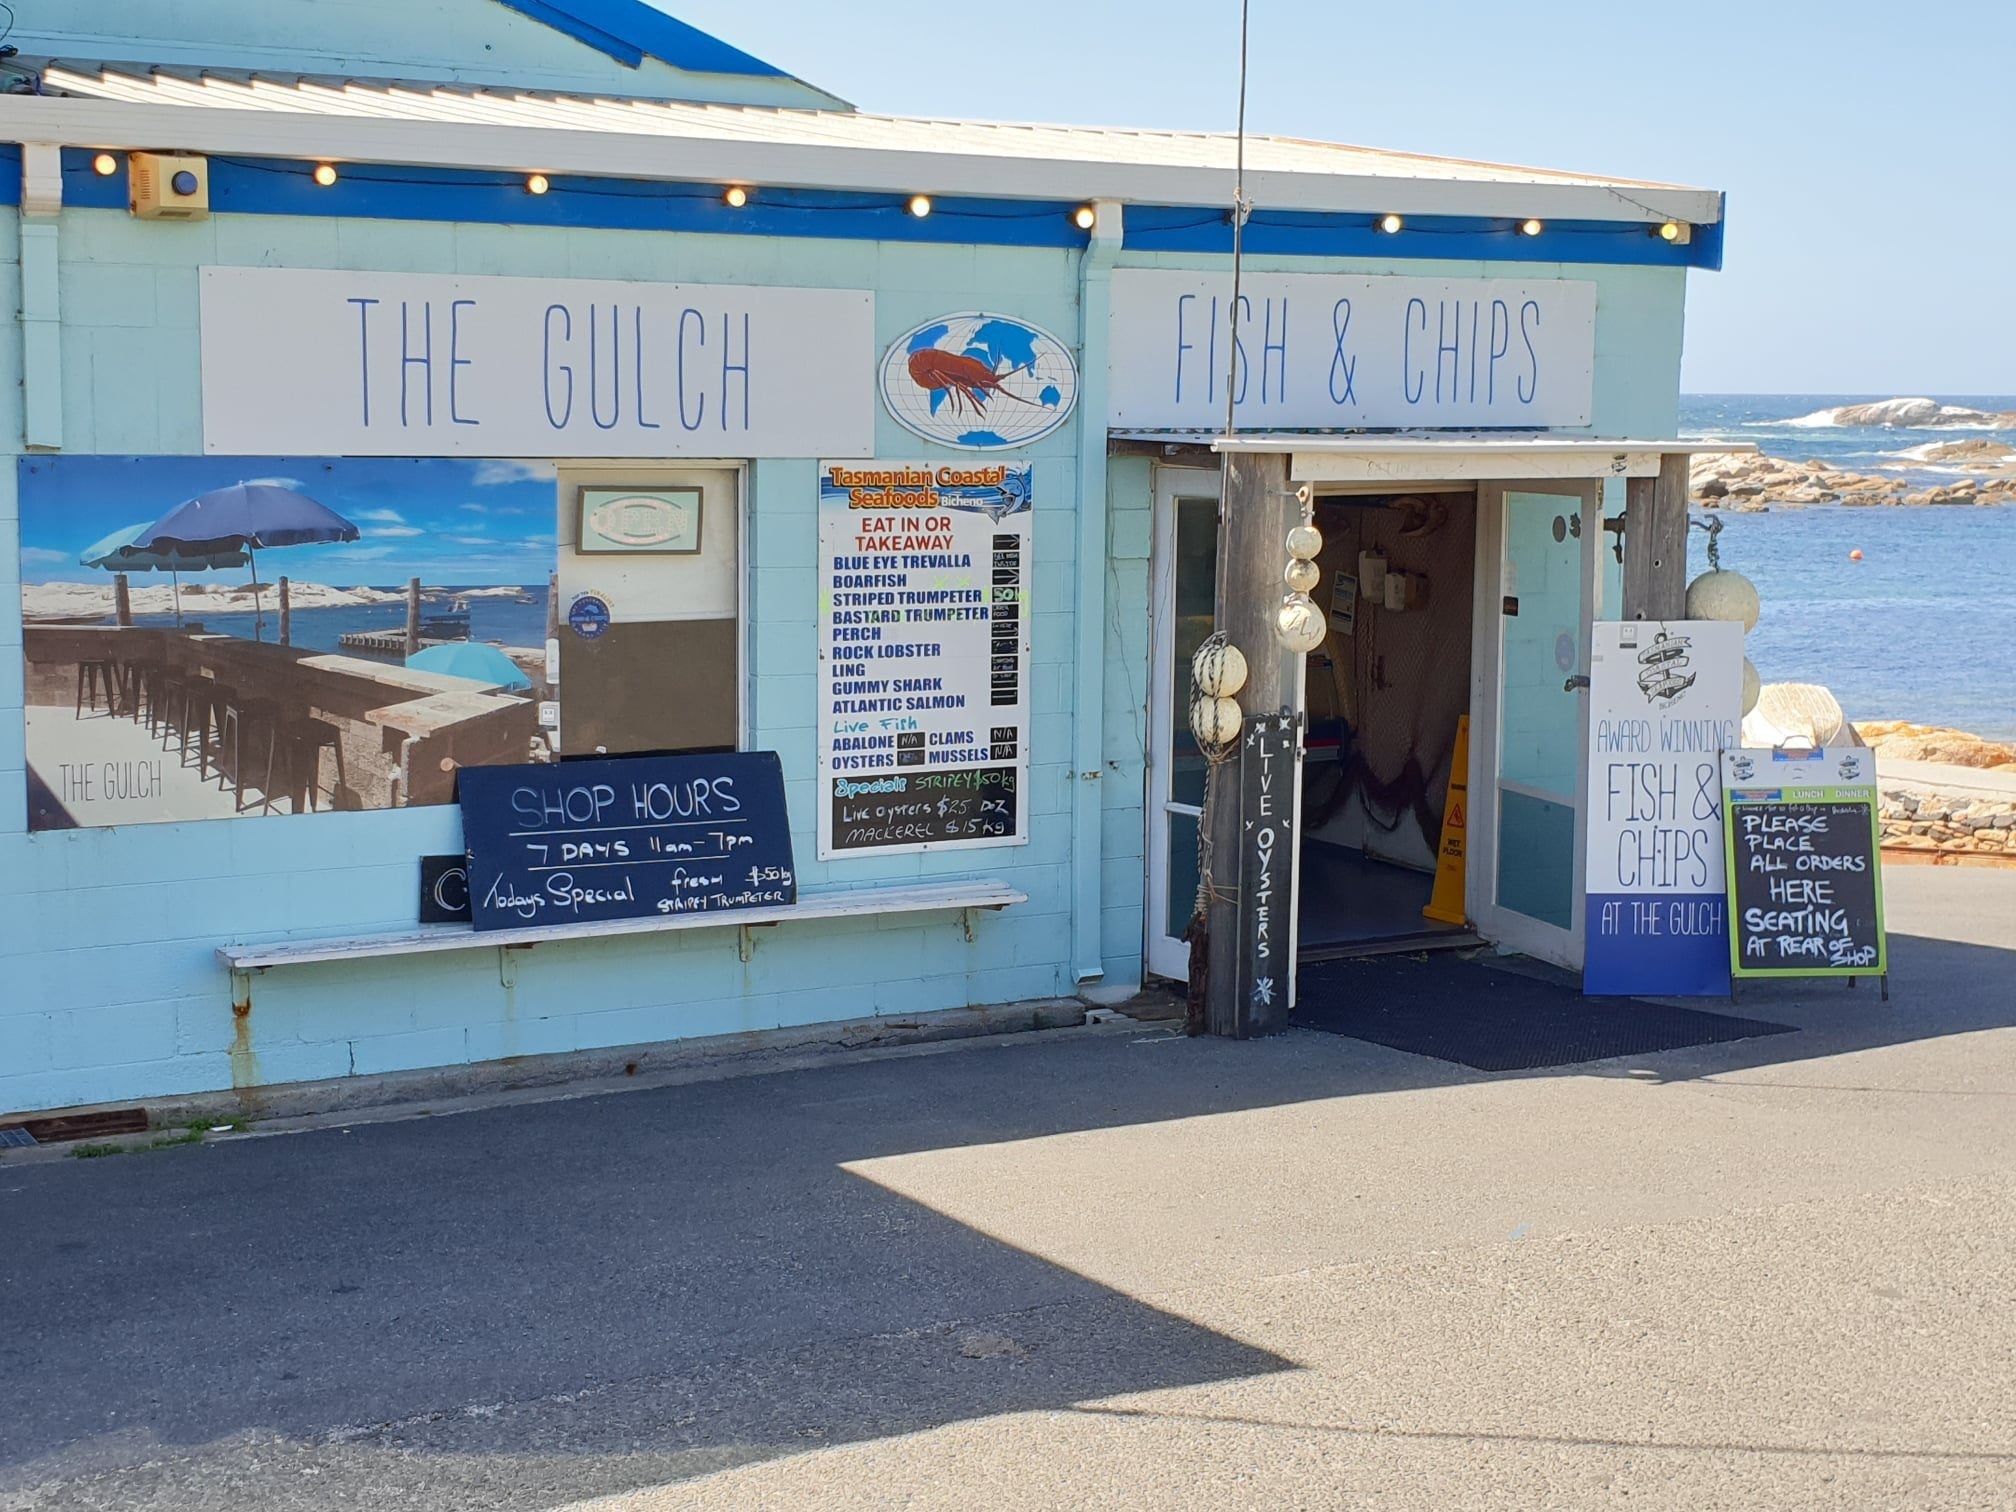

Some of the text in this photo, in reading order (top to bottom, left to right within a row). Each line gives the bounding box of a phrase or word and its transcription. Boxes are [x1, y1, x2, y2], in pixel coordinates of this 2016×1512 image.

[1175, 294, 1540, 406] FISH & CHIPS
[348, 298, 750, 432] THE GULCH
[829, 465, 1006, 488] Tasmanian Coastal
[849, 486, 984, 509] Seafoods Bicheno
[862, 516, 952, 533] EAT IN OR
[855, 534, 954, 552] TAKEAWAY
[833, 554, 971, 570] BLUE EYE TREVALLA
[832, 574, 907, 589] BOARFISH
[832, 590, 982, 607] STRIPED TRUMPETER
[832, 609, 901, 625] BASTARD
[905, 607, 989, 622] TRUMPETER
[832, 627, 881, 642] PERCH
[832, 644, 941, 660] ROCK LOBSTER
[832, 663, 866, 678] LING
[832, 678, 942, 696] GUMMY SHARK
[832, 695, 965, 714] ATLANTIC SALMON
[834, 715, 918, 734] Live Fish
[832, 727, 1014, 751] ABALONE N/A CLAMS N/A
[1597, 719, 1733, 753] AWARD WINNING
[832, 753, 894, 770] OYSTERS
[929, 748, 989, 764] MUSSELS
[994, 745, 1013, 759] N/A
[59, 760, 162, 802] THE GULCH
[834, 777, 908, 800] Specials
[915, 772, 972, 791] STRIPEY
[511, 776, 741, 828] SHOP HOURS
[1607, 763, 1721, 822] FISH &
[1792, 789, 1825, 799] LUNCH
[1835, 788, 1870, 798] DINNER
[937, 794, 971, 818] $25
[845, 822, 934, 844] MACKEREL
[1742, 814, 1829, 833] PLEASE
[526, 843, 549, 865] 7
[561, 840, 631, 862] DAYS
[1255, 736, 1276, 959] LIVE OYSTERS
[1442, 846, 1463, 858] FLOOR
[1744, 834, 1815, 852] PLACE
[1617, 828, 1708, 888] CHIPS
[1750, 853, 1865, 874] ALL ORDERS
[483, 872, 546, 918] Todays
[546, 872, 635, 914] Special
[709, 891, 785, 908] TRUMPETER
[1770, 876, 1835, 904] HERE
[1601, 901, 1722, 937] AT THE GULCH
[1746, 934, 1854, 957] AT REAR OF
[1830, 945, 1877, 967] SHOP
